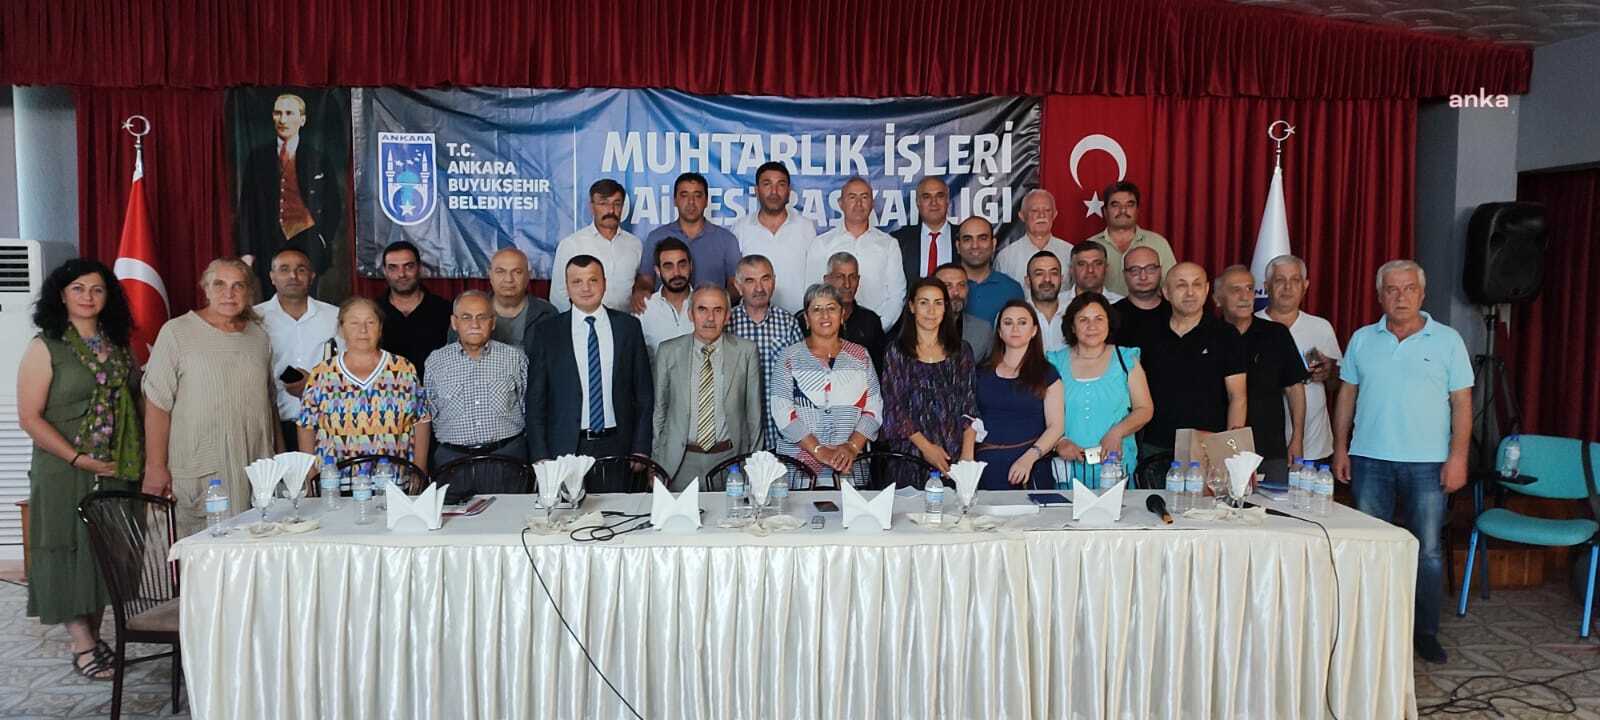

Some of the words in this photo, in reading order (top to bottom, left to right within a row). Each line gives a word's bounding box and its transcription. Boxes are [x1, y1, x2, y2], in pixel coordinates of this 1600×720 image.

[382, 134, 433, 142] ANKARA
[446, 142, 476, 156] T.C.
[601, 131, 870, 176] MUHTARLIK
[884, 121, 1014, 183] İŞLERİ
[447, 161, 517, 175] ANKARA
[619, 184, 758, 225] AİESİ
[785, 175, 1012, 227] AAIĞI
